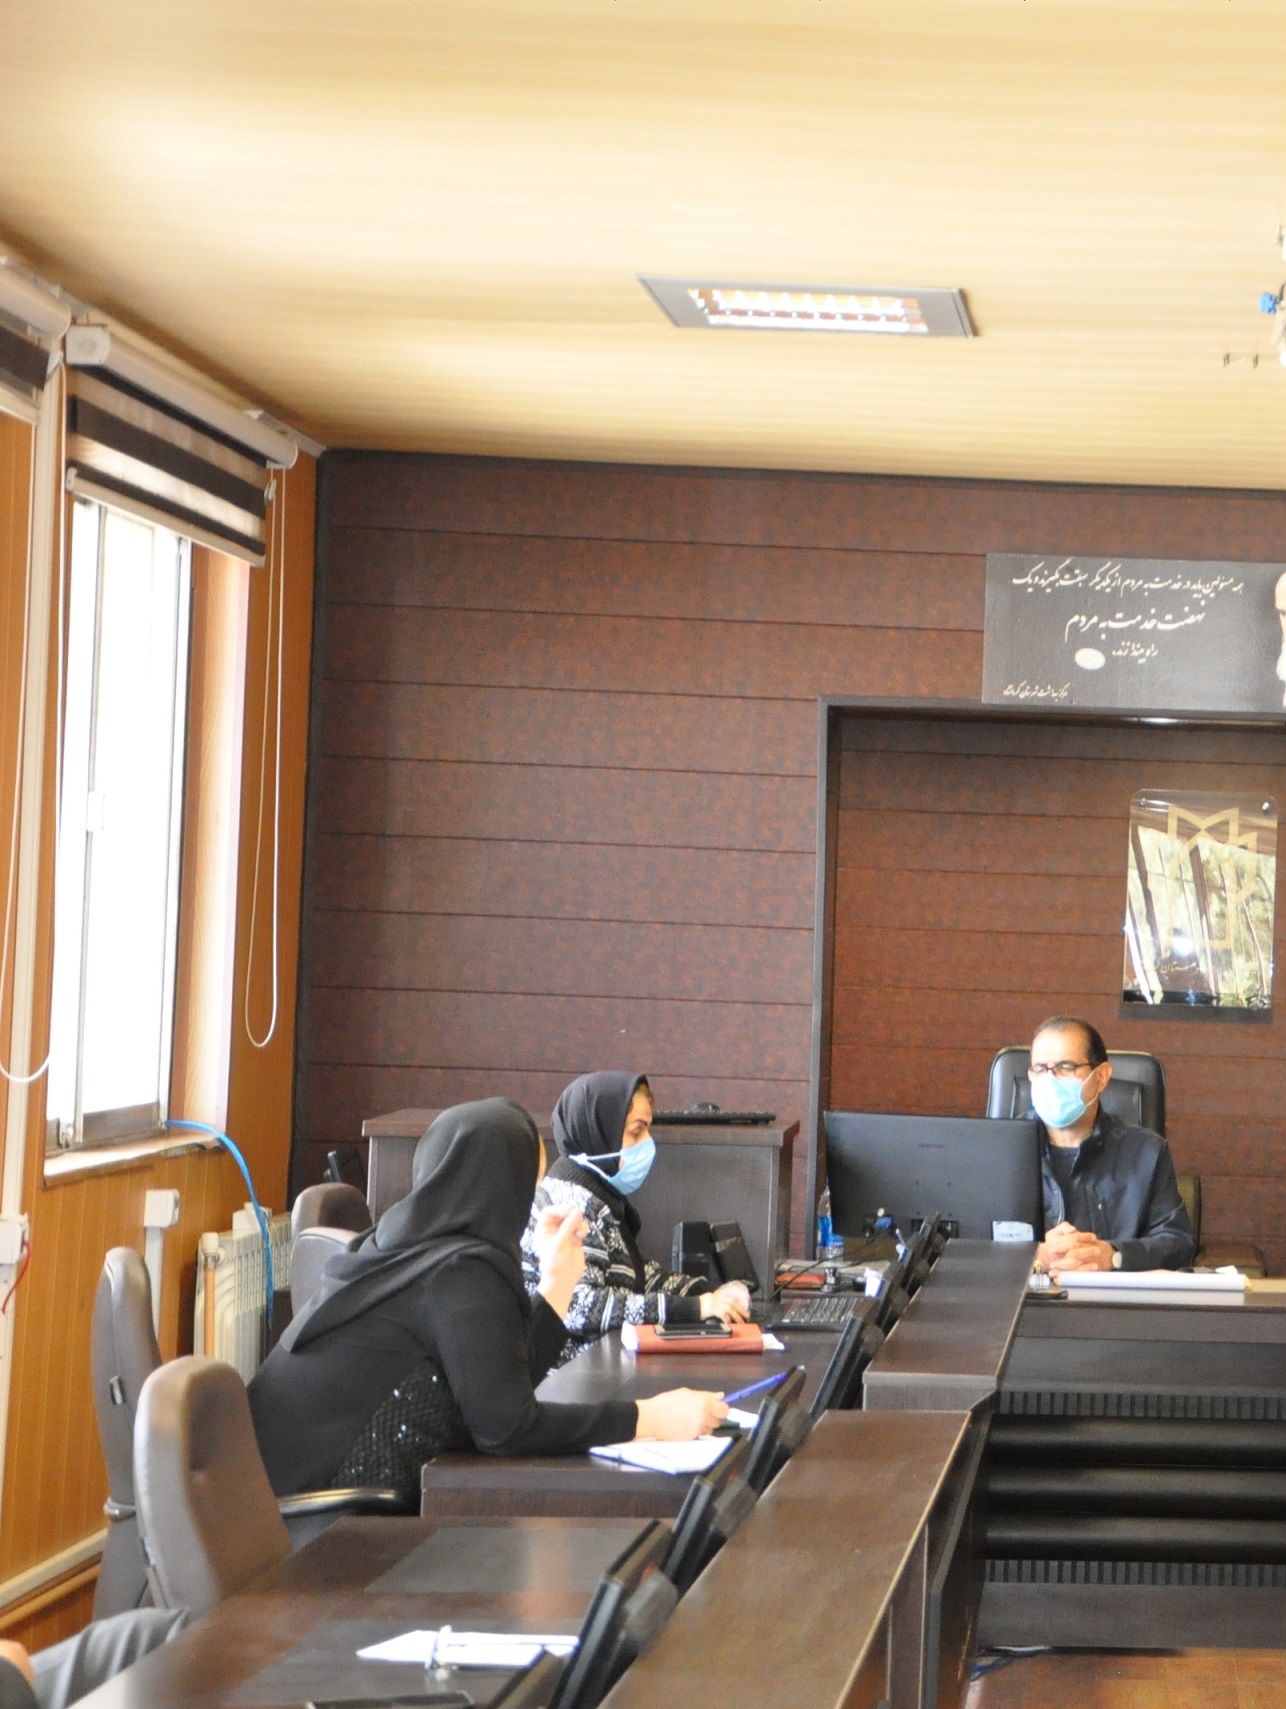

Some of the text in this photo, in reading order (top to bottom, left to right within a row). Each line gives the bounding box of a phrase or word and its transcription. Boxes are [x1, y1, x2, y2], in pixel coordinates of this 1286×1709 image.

[1012, 561, 1045, 593] یک
[1059, 569, 1089, 588] سبقت
[1111, 572, 1121, 587] از
[1149, 574, 1182, 590] خدمت
[1120, 579, 1144, 598] مردم
[1065, 600, 1206, 643] نهضت خدمت به مردم
